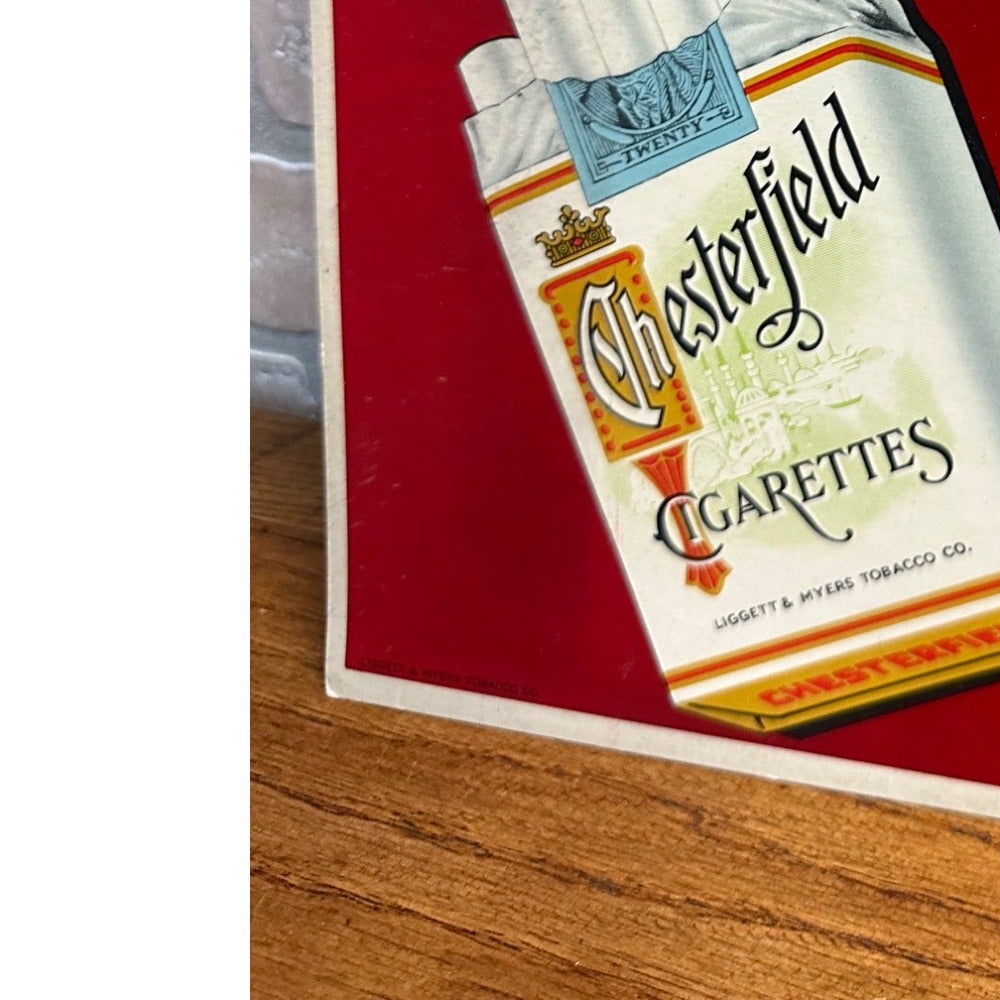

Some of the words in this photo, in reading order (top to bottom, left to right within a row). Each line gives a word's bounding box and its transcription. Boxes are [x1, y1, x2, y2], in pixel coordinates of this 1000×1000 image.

[620, 115, 704, 165] TWENTY
[578, 90, 881, 429] Chesterfield
[653, 415, 955, 562] CIGARETTES
[714, 600, 778, 630] LIGGETT
[781, 595, 794, 609] &
[799, 576, 855, 603] MYERS
[859, 551, 936, 584] TOBACCO
[942, 541, 972, 558] CO.
